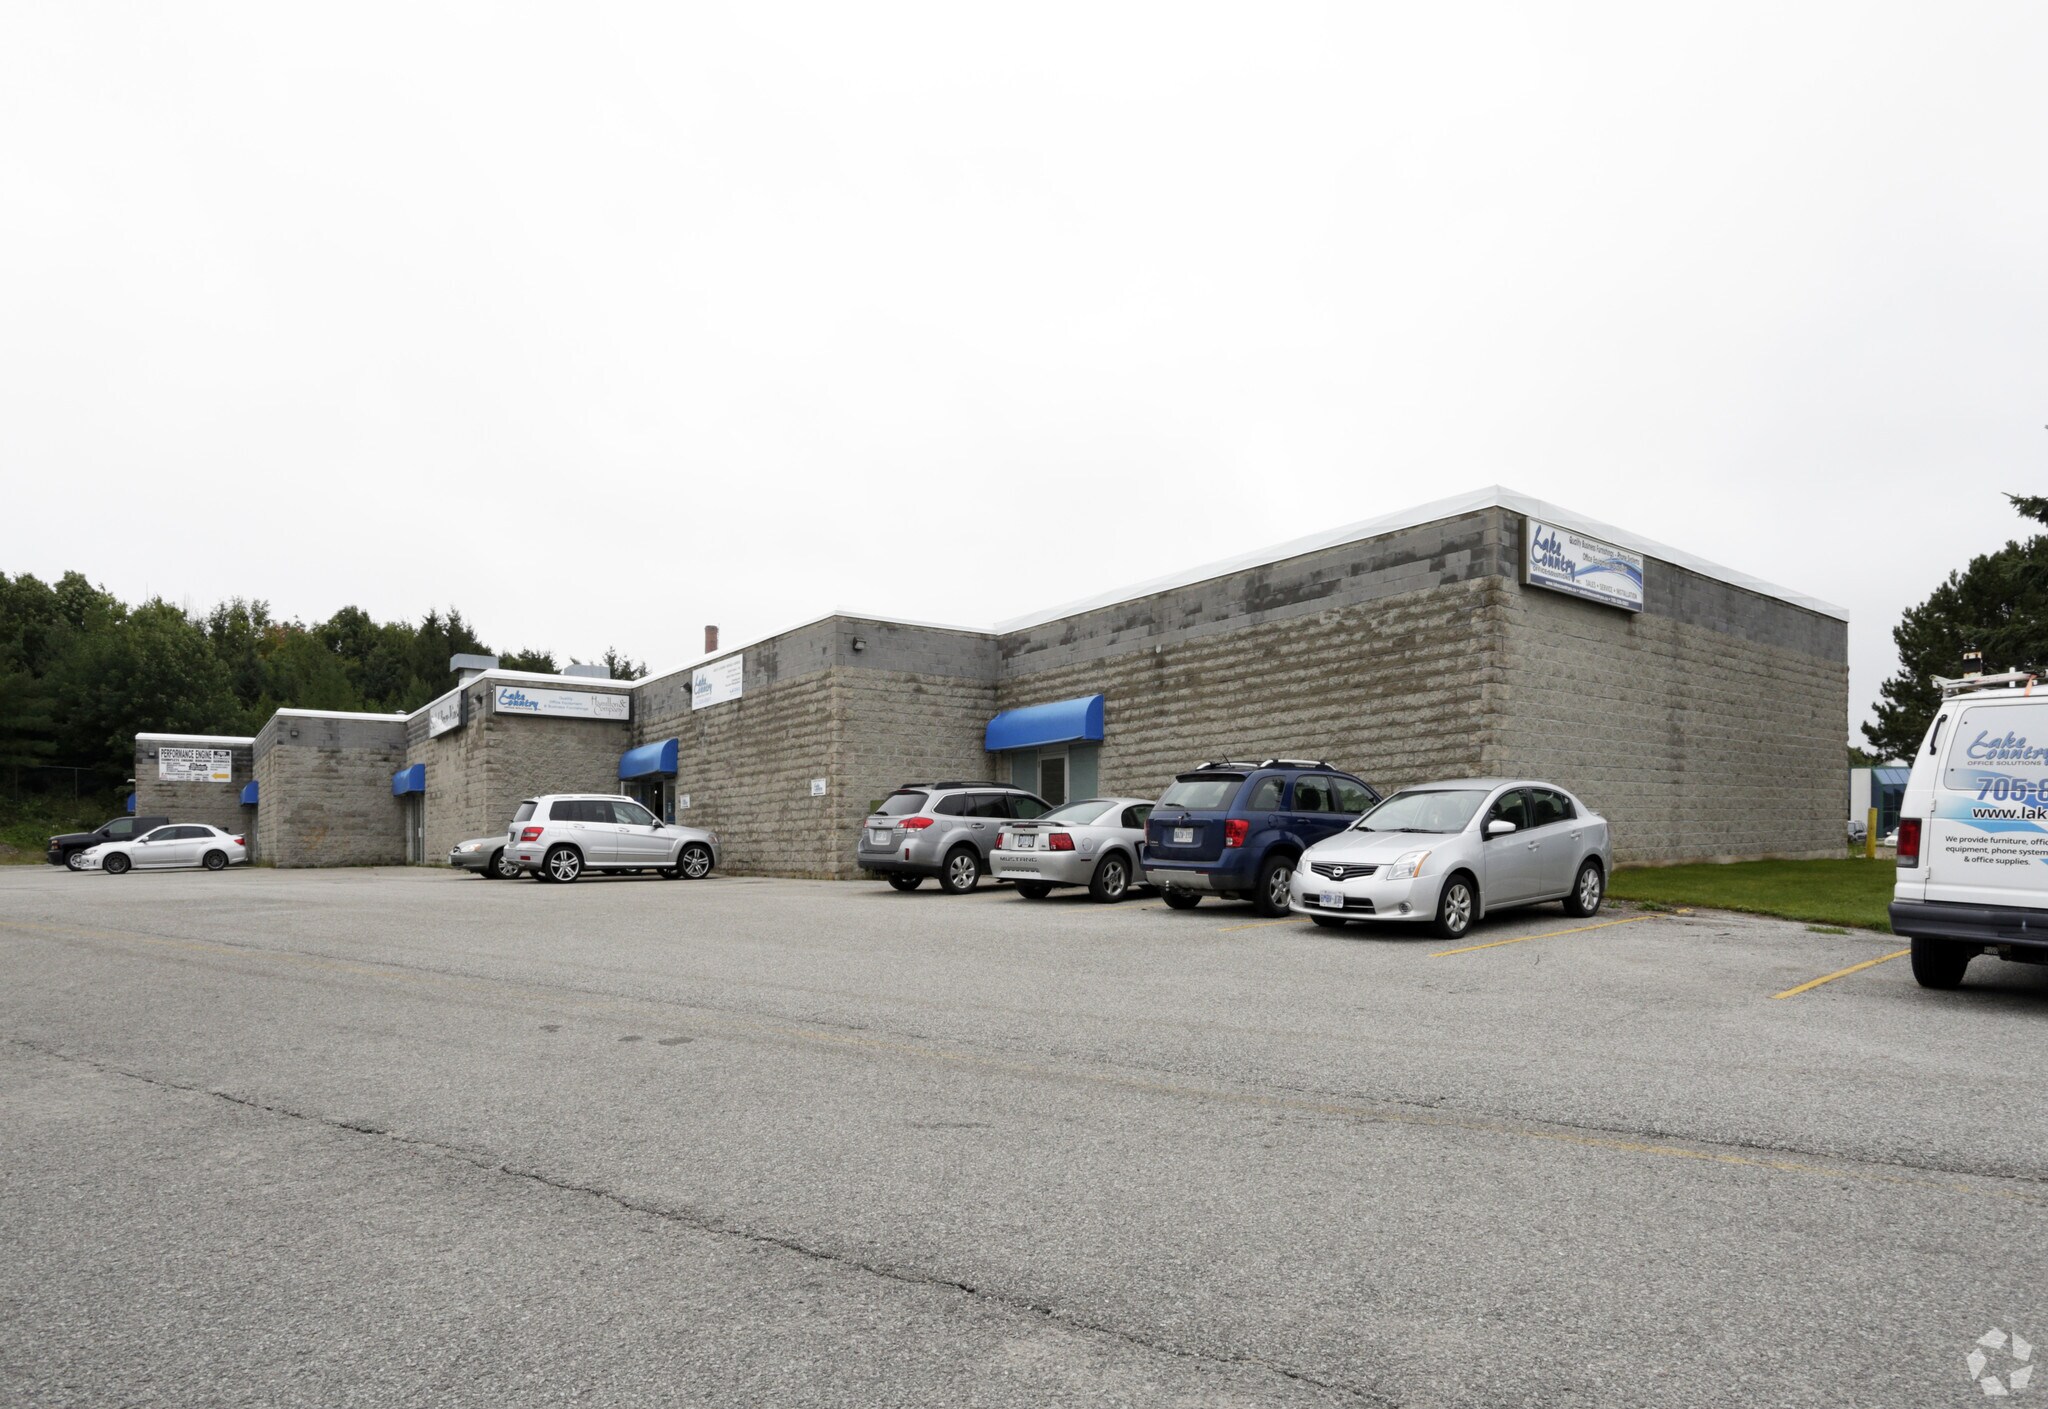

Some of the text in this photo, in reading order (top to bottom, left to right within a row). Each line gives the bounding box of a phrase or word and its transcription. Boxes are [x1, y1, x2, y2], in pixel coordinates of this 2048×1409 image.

[1532, 525, 1561, 556] Lake
[1531, 541, 1576, 582] Country
[499, 688, 525, 701] Lake
[498, 696, 539, 711] Country
[1968, 730, 2027, 749] Lake
[161, 749, 194, 759] PERFORMANCE
[195, 750, 212, 759] ENGINE
[1959, 836, 1989, 844] provide
[1990, 837, 2029, 845] furniture,
[1945, 846, 1989, 854] equipment,
[1991, 847, 2017, 855] phone
